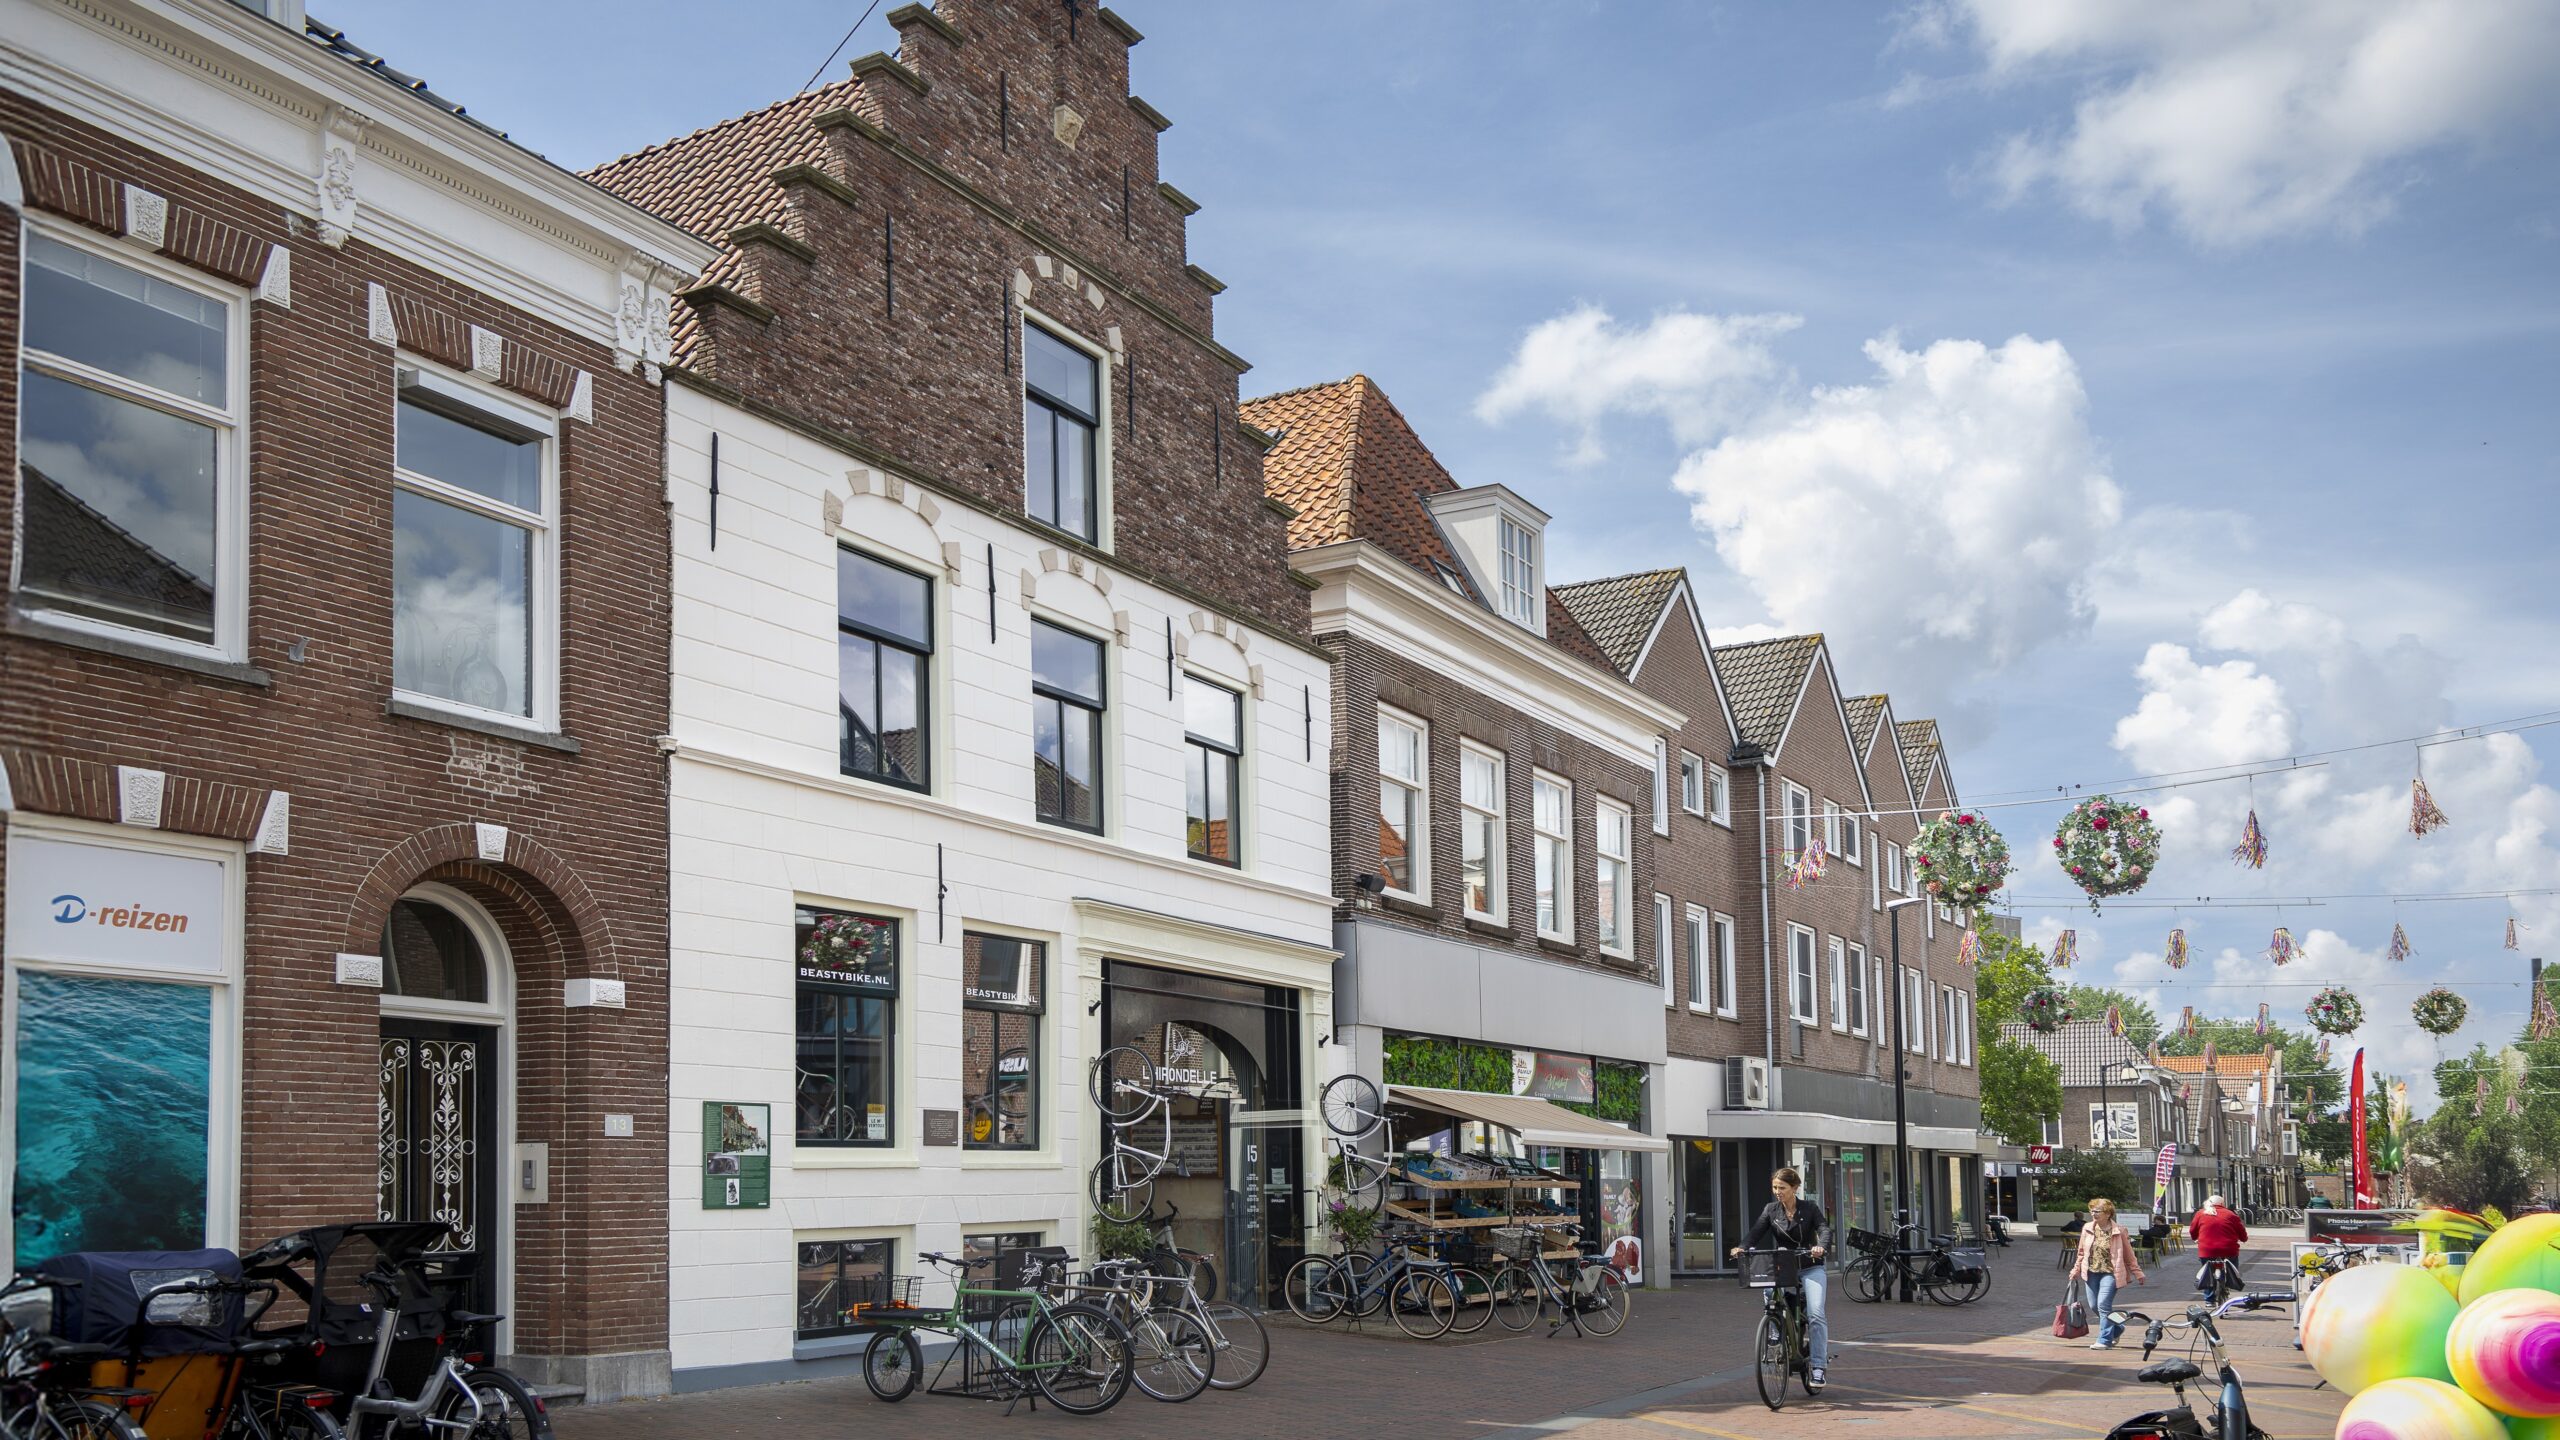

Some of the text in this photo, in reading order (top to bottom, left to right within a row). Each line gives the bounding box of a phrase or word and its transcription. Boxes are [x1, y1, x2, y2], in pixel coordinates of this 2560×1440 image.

[51, 894, 189, 934] D-reizen
[800, 967, 890, 985] BEASTYBIKE.NL
[611, 1119, 626, 1130] 13
[1247, 1144, 1259, 1162] 15
[2031, 1148, 2050, 1163] illy
[2021, 1166, 2034, 1174] De
